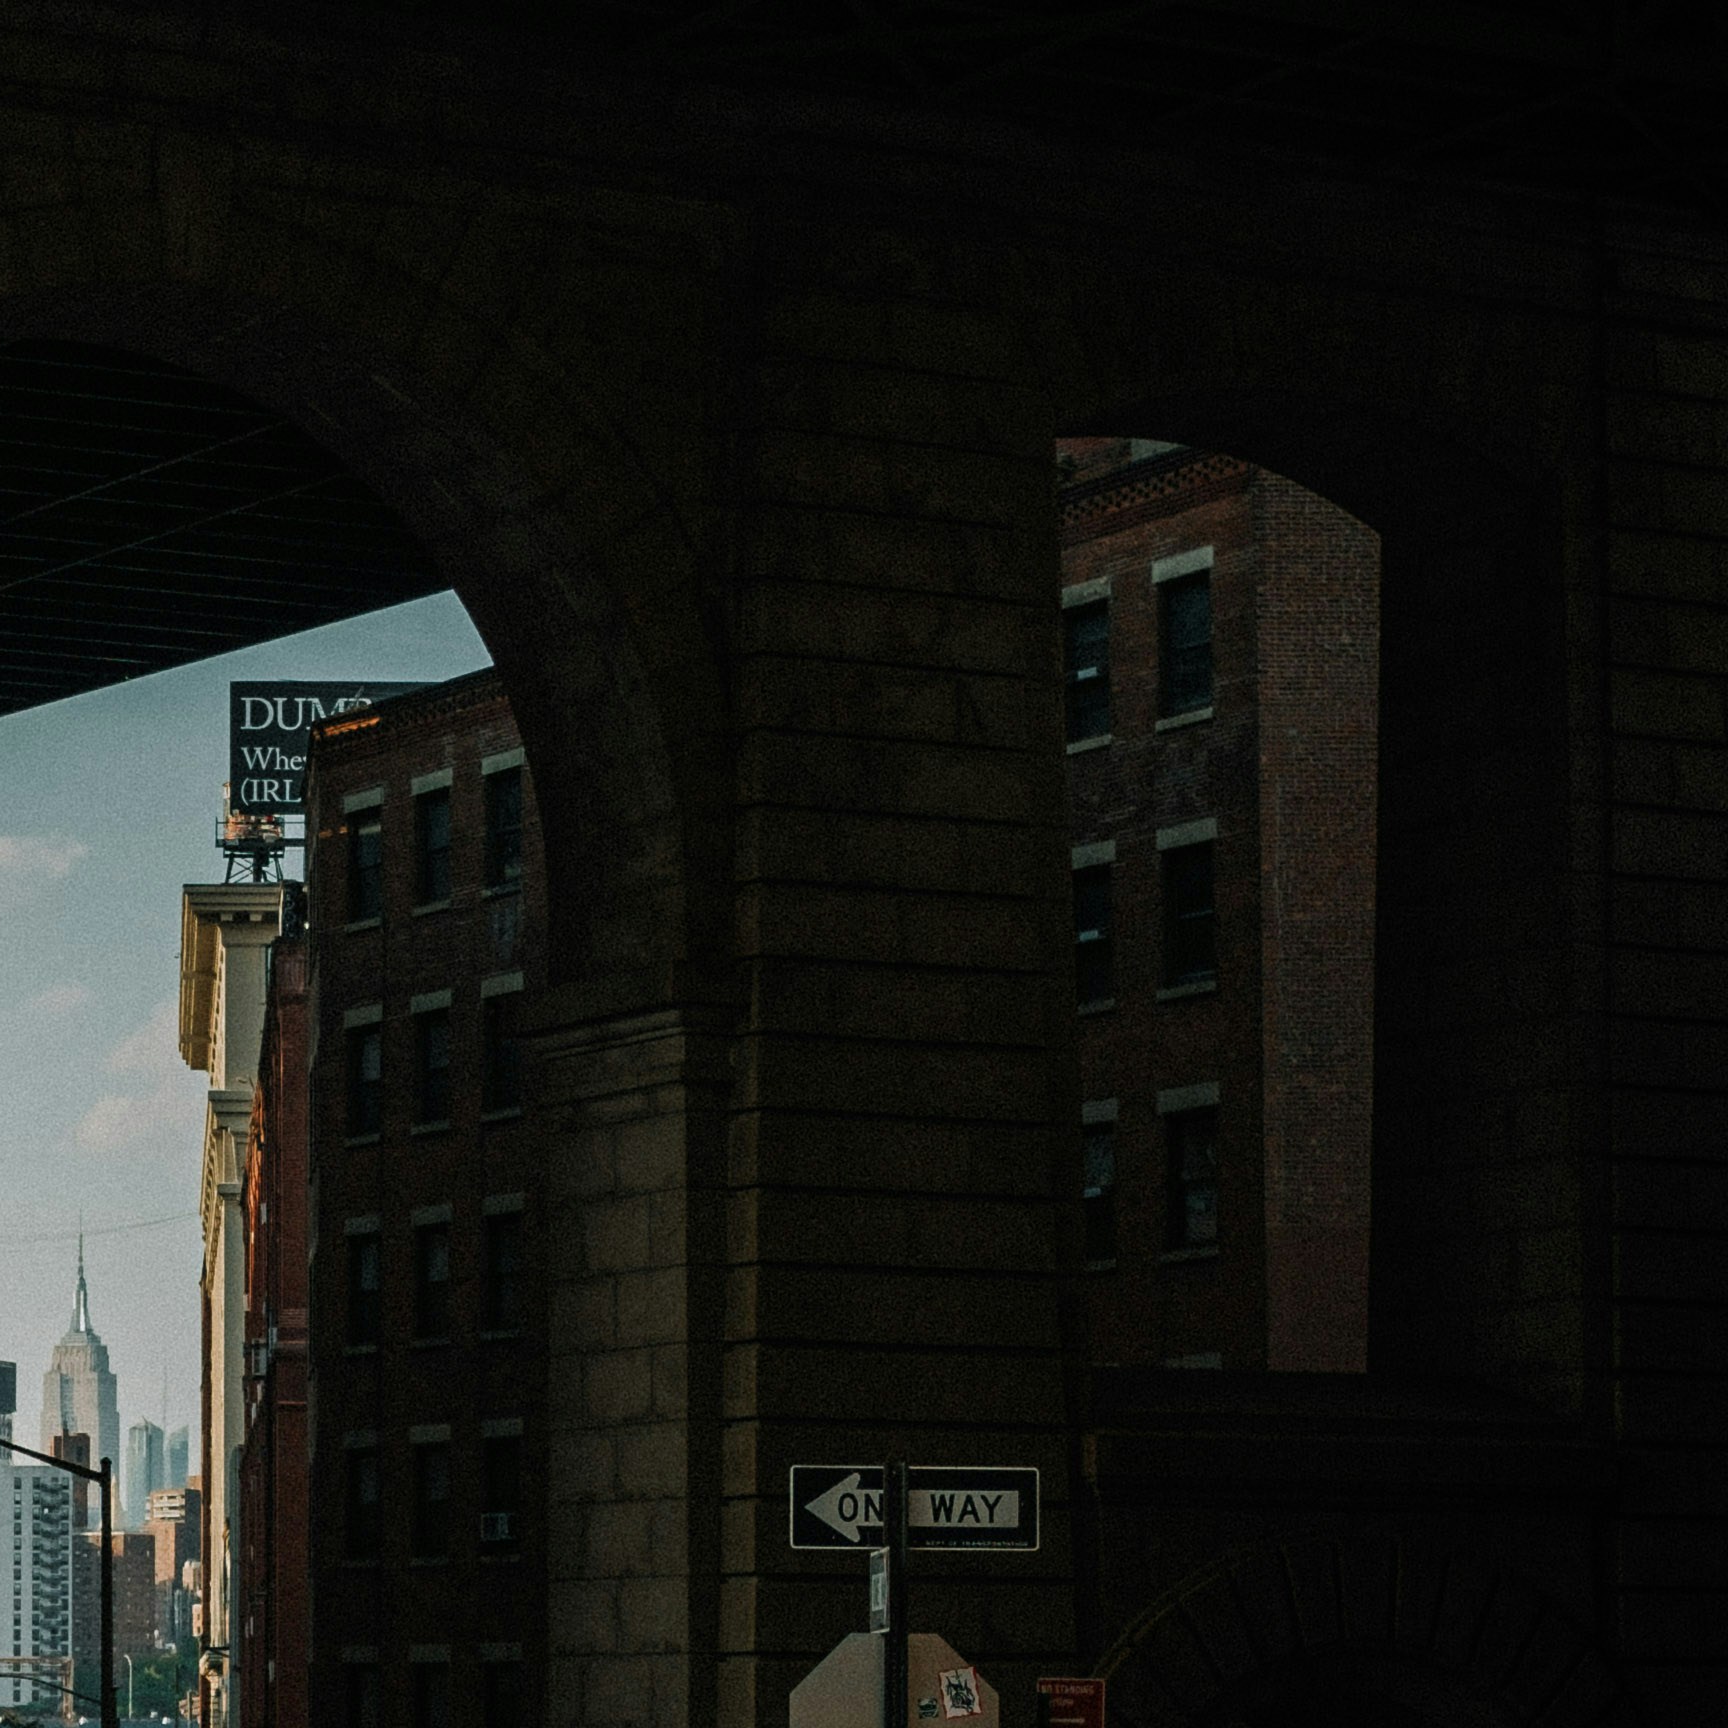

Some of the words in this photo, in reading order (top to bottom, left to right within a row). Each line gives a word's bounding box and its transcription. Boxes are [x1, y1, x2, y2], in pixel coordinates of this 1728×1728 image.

[241, 746, 307, 771] Whe
[838, 1493, 885, 1522] ON
[930, 1494, 1003, 1523] WAY
